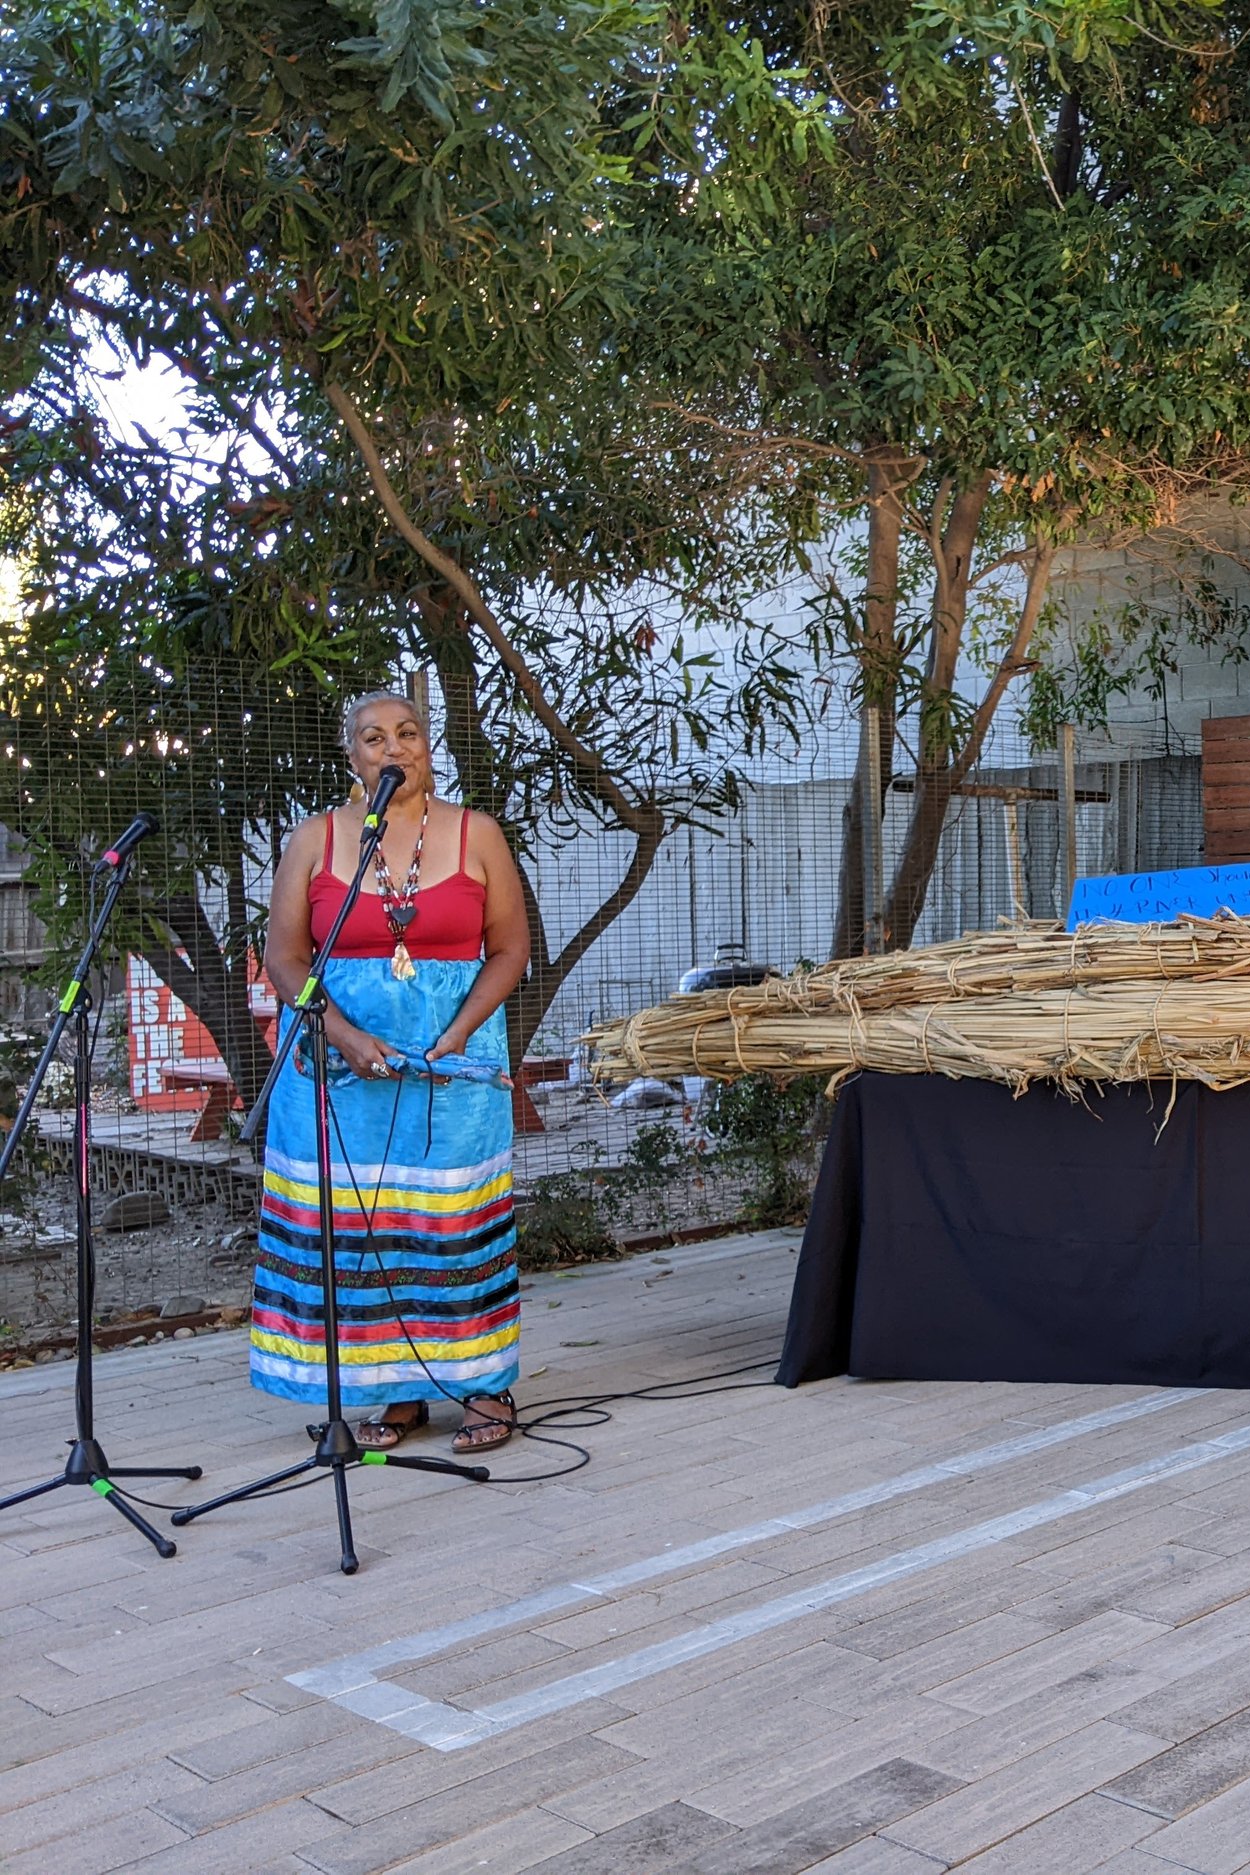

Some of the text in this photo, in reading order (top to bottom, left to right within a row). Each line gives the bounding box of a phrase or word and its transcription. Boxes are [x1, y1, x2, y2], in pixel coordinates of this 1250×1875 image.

[1083, 879, 1118, 898] NO
[131, 989, 187, 1024] IS A
[132, 1023, 184, 1060] THE
